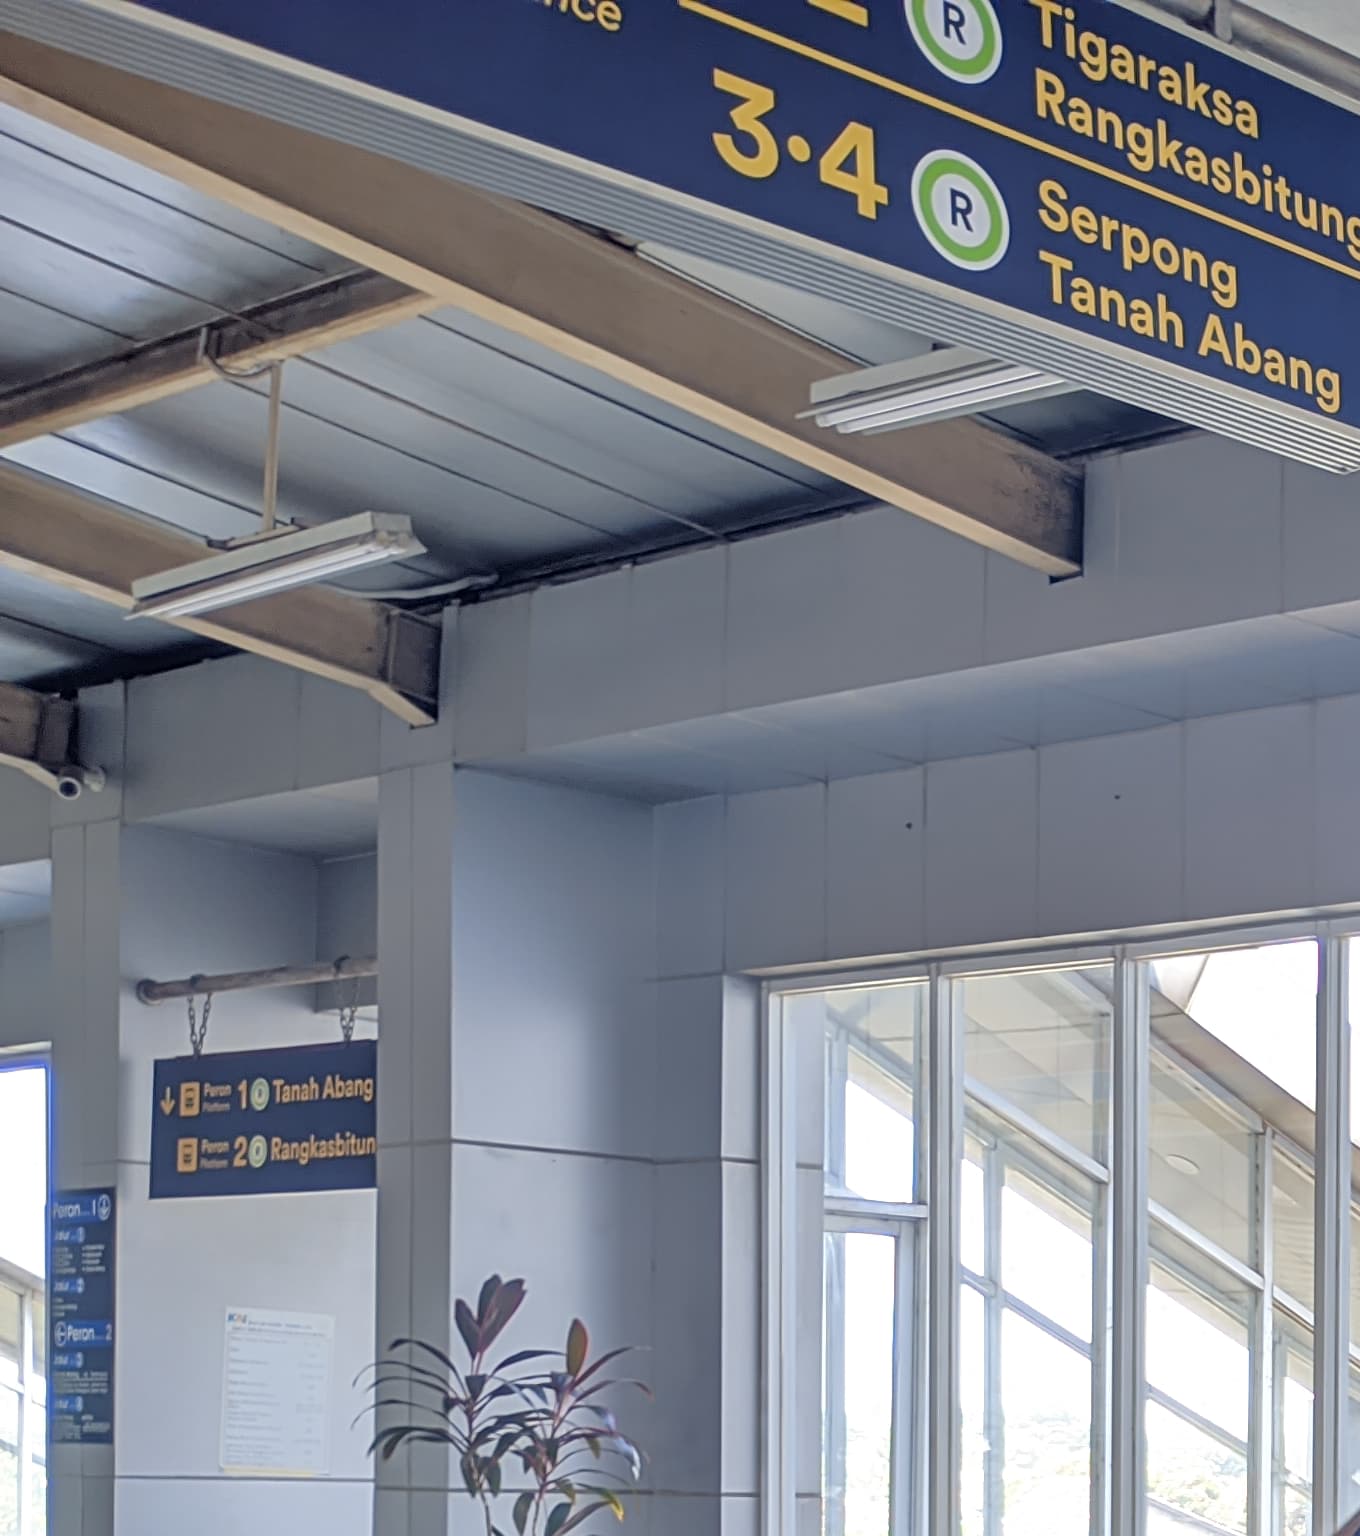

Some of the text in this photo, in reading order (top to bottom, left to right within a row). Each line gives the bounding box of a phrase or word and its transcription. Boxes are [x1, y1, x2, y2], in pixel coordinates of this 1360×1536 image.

[1029, 0, 1258, 138] Tigaraksa
[950, 187, 973, 233] R
[1038, 179, 1238, 308] Serpong
[1039, 250, 1341, 413] Tanah Abang
[204, 1074, 374, 1109] Peron 1 Tanah Abang
[201, 1131, 377, 1167] Peron 2 Rangkasbitun
